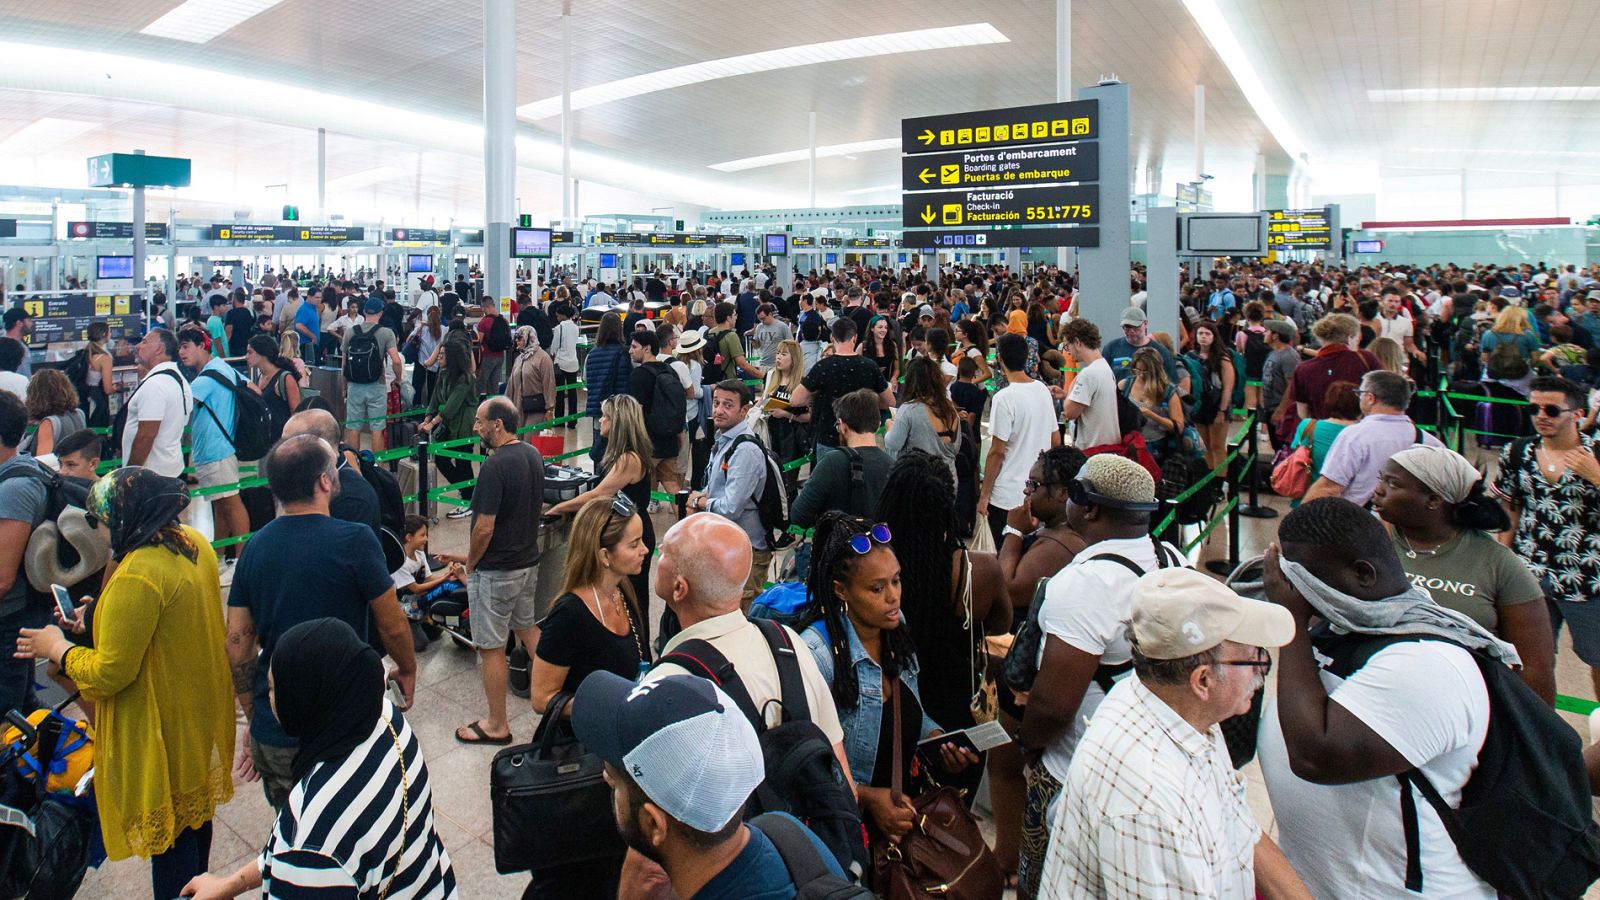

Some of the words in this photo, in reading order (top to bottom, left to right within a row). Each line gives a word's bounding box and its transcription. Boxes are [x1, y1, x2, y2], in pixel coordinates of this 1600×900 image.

[964, 154, 995, 163] Portes
[997, 146, 1077, 160] d'embarcament
[964, 163, 996, 172] Boarding
[998, 162, 1021, 171] gates
[964, 173, 1000, 182] Puertas
[1003, 171, 1016, 180] de
[1018, 169, 1070, 179] embarque
[966, 190, 1014, 201] Facturació
[966, 202, 1001, 211] Check-in
[967, 211, 1020, 221] Facturación
[1026, 206, 1055, 220] 551
[1061, 205, 1092, 219] 775
[1404, 571, 1476, 597] TRONG
[1182, 621, 1205, 645] 3
